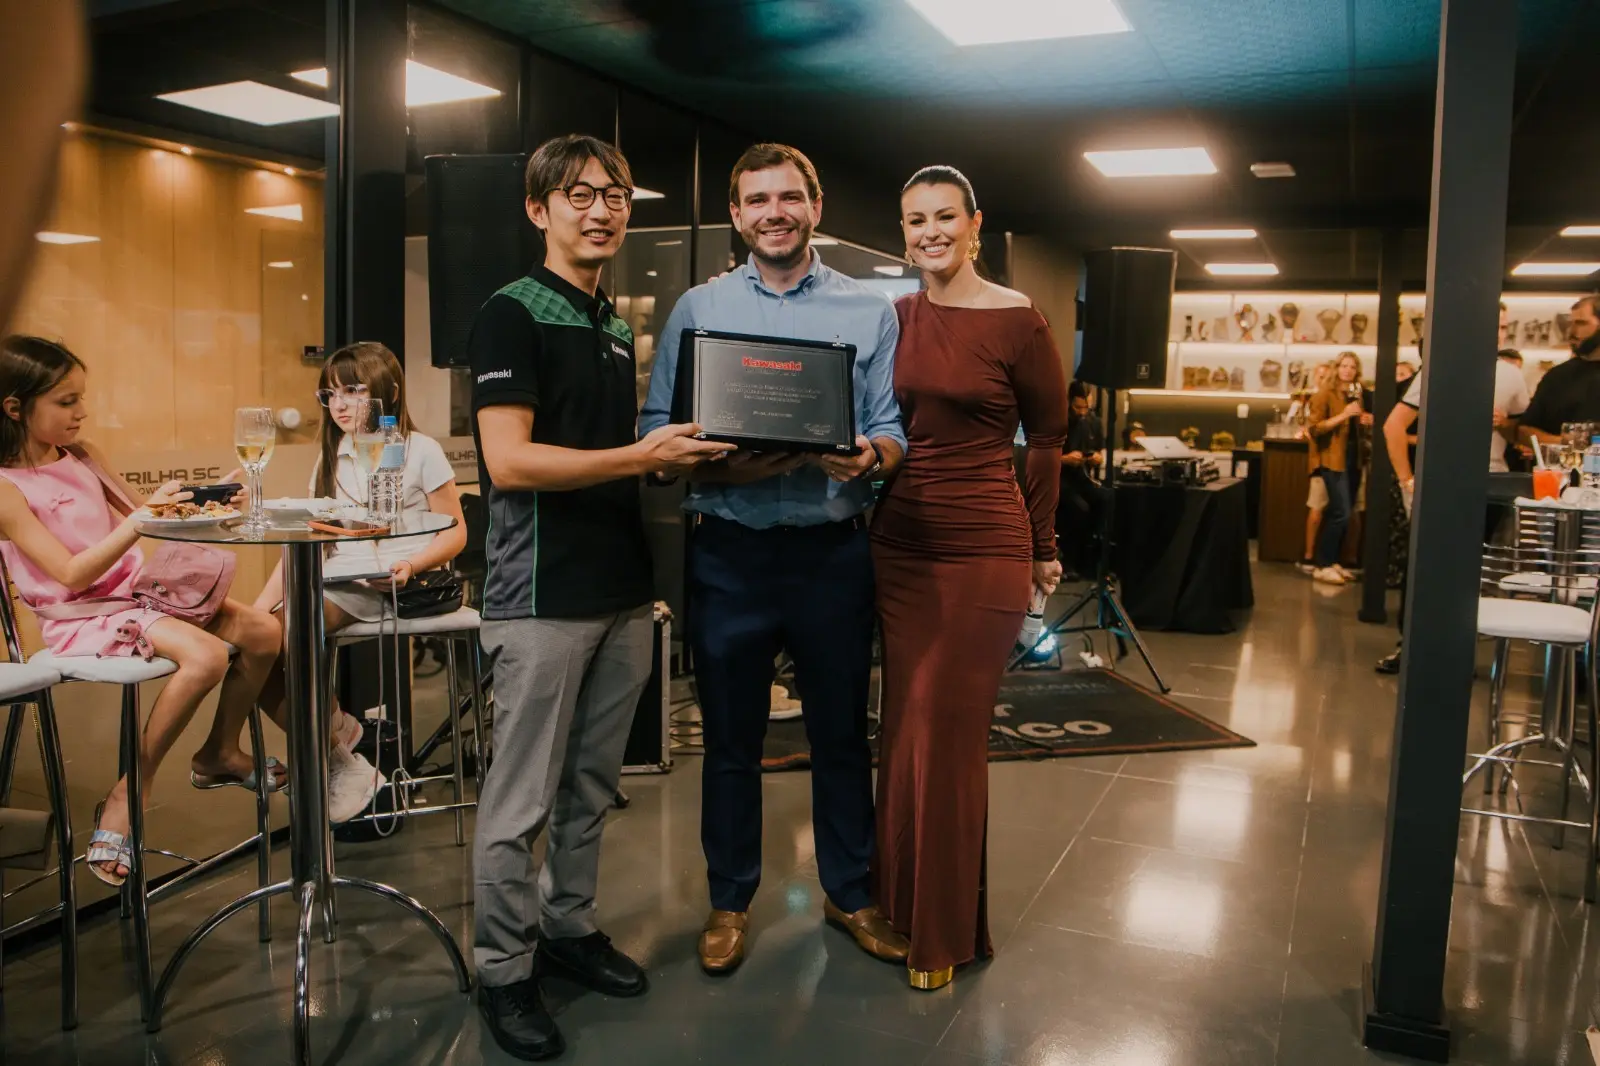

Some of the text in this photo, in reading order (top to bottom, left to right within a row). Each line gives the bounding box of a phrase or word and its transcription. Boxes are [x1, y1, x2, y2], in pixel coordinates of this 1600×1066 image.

[742, 356, 803, 372] Kawasaki
[477, 369, 512, 384] Kawasaki
[119, 467, 220, 485] RILHA SC
